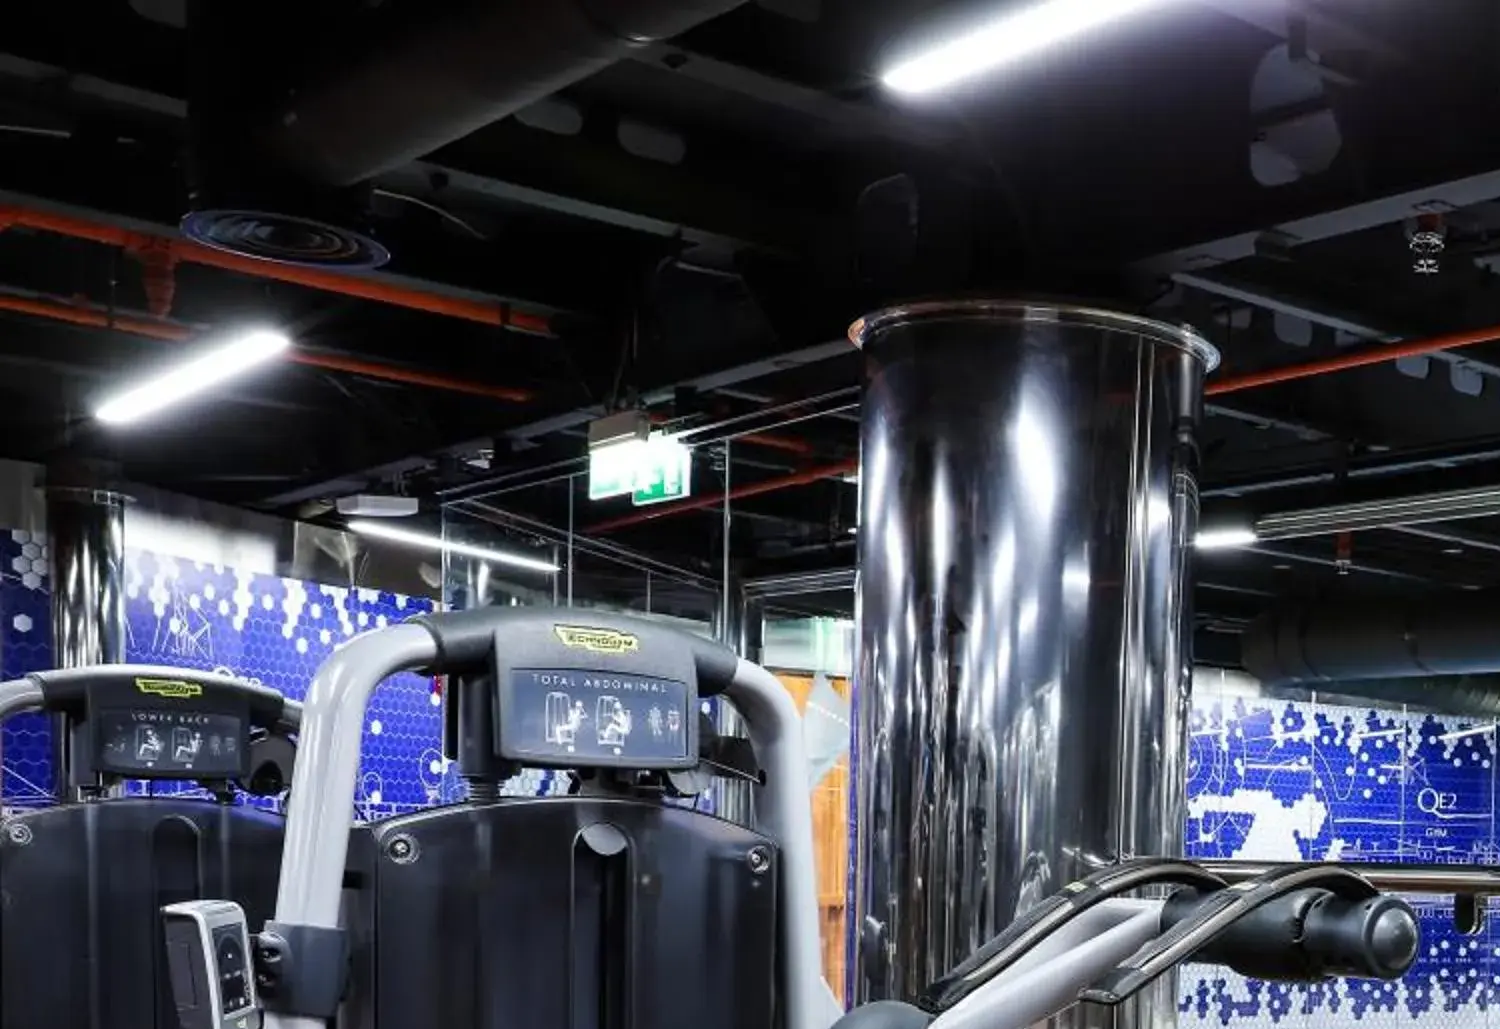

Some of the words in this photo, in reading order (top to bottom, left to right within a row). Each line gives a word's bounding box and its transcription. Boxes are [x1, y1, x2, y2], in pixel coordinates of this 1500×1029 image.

[532, 673, 577, 687] TOTAL
[583, 679, 668, 693] ABDOMINAL
[1417, 787, 1460, 817] QE2
